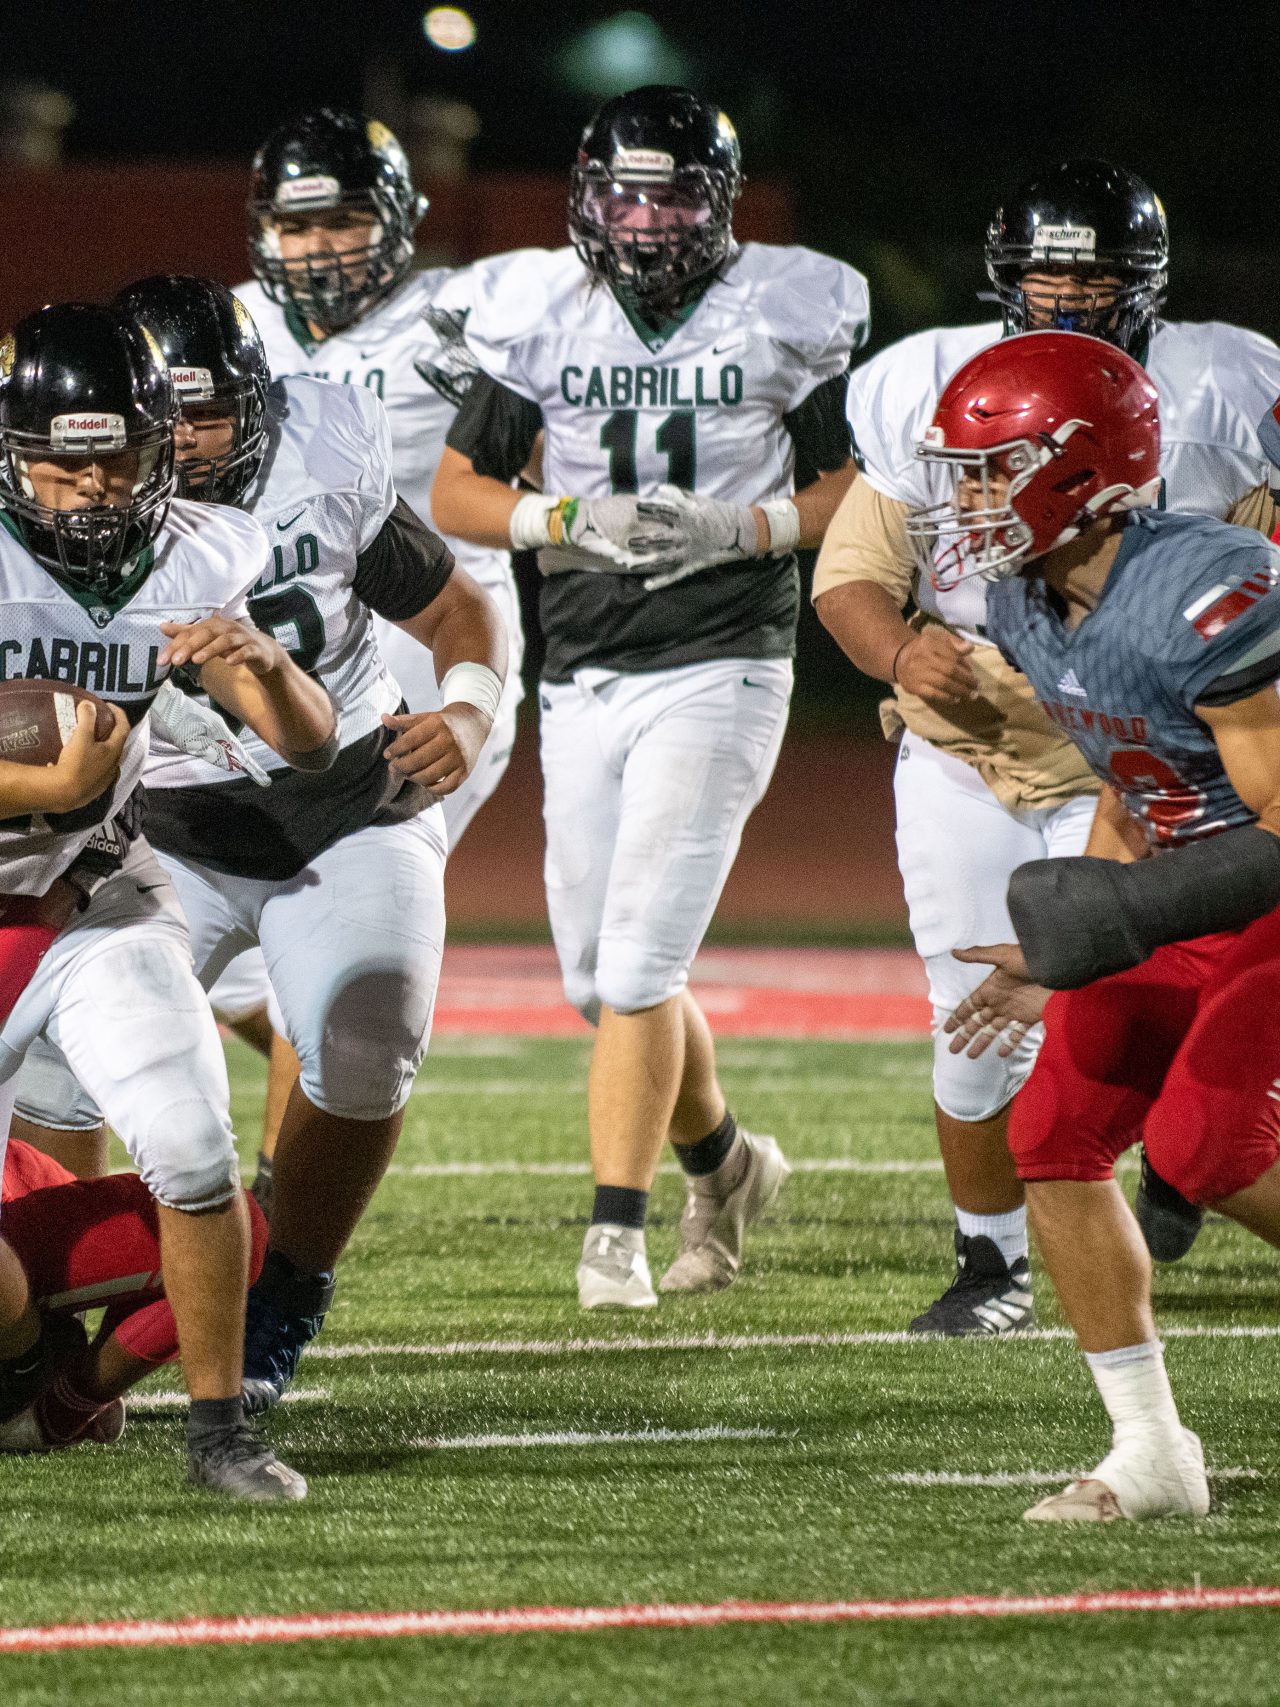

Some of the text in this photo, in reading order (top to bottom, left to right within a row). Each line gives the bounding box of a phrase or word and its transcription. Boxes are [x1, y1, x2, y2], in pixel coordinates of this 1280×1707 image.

[561, 364, 743, 407] CABRILLO
[68, 418, 108, 430] Riddell
[599, 409, 697, 496] 11
[86, 836, 120, 855] didas
